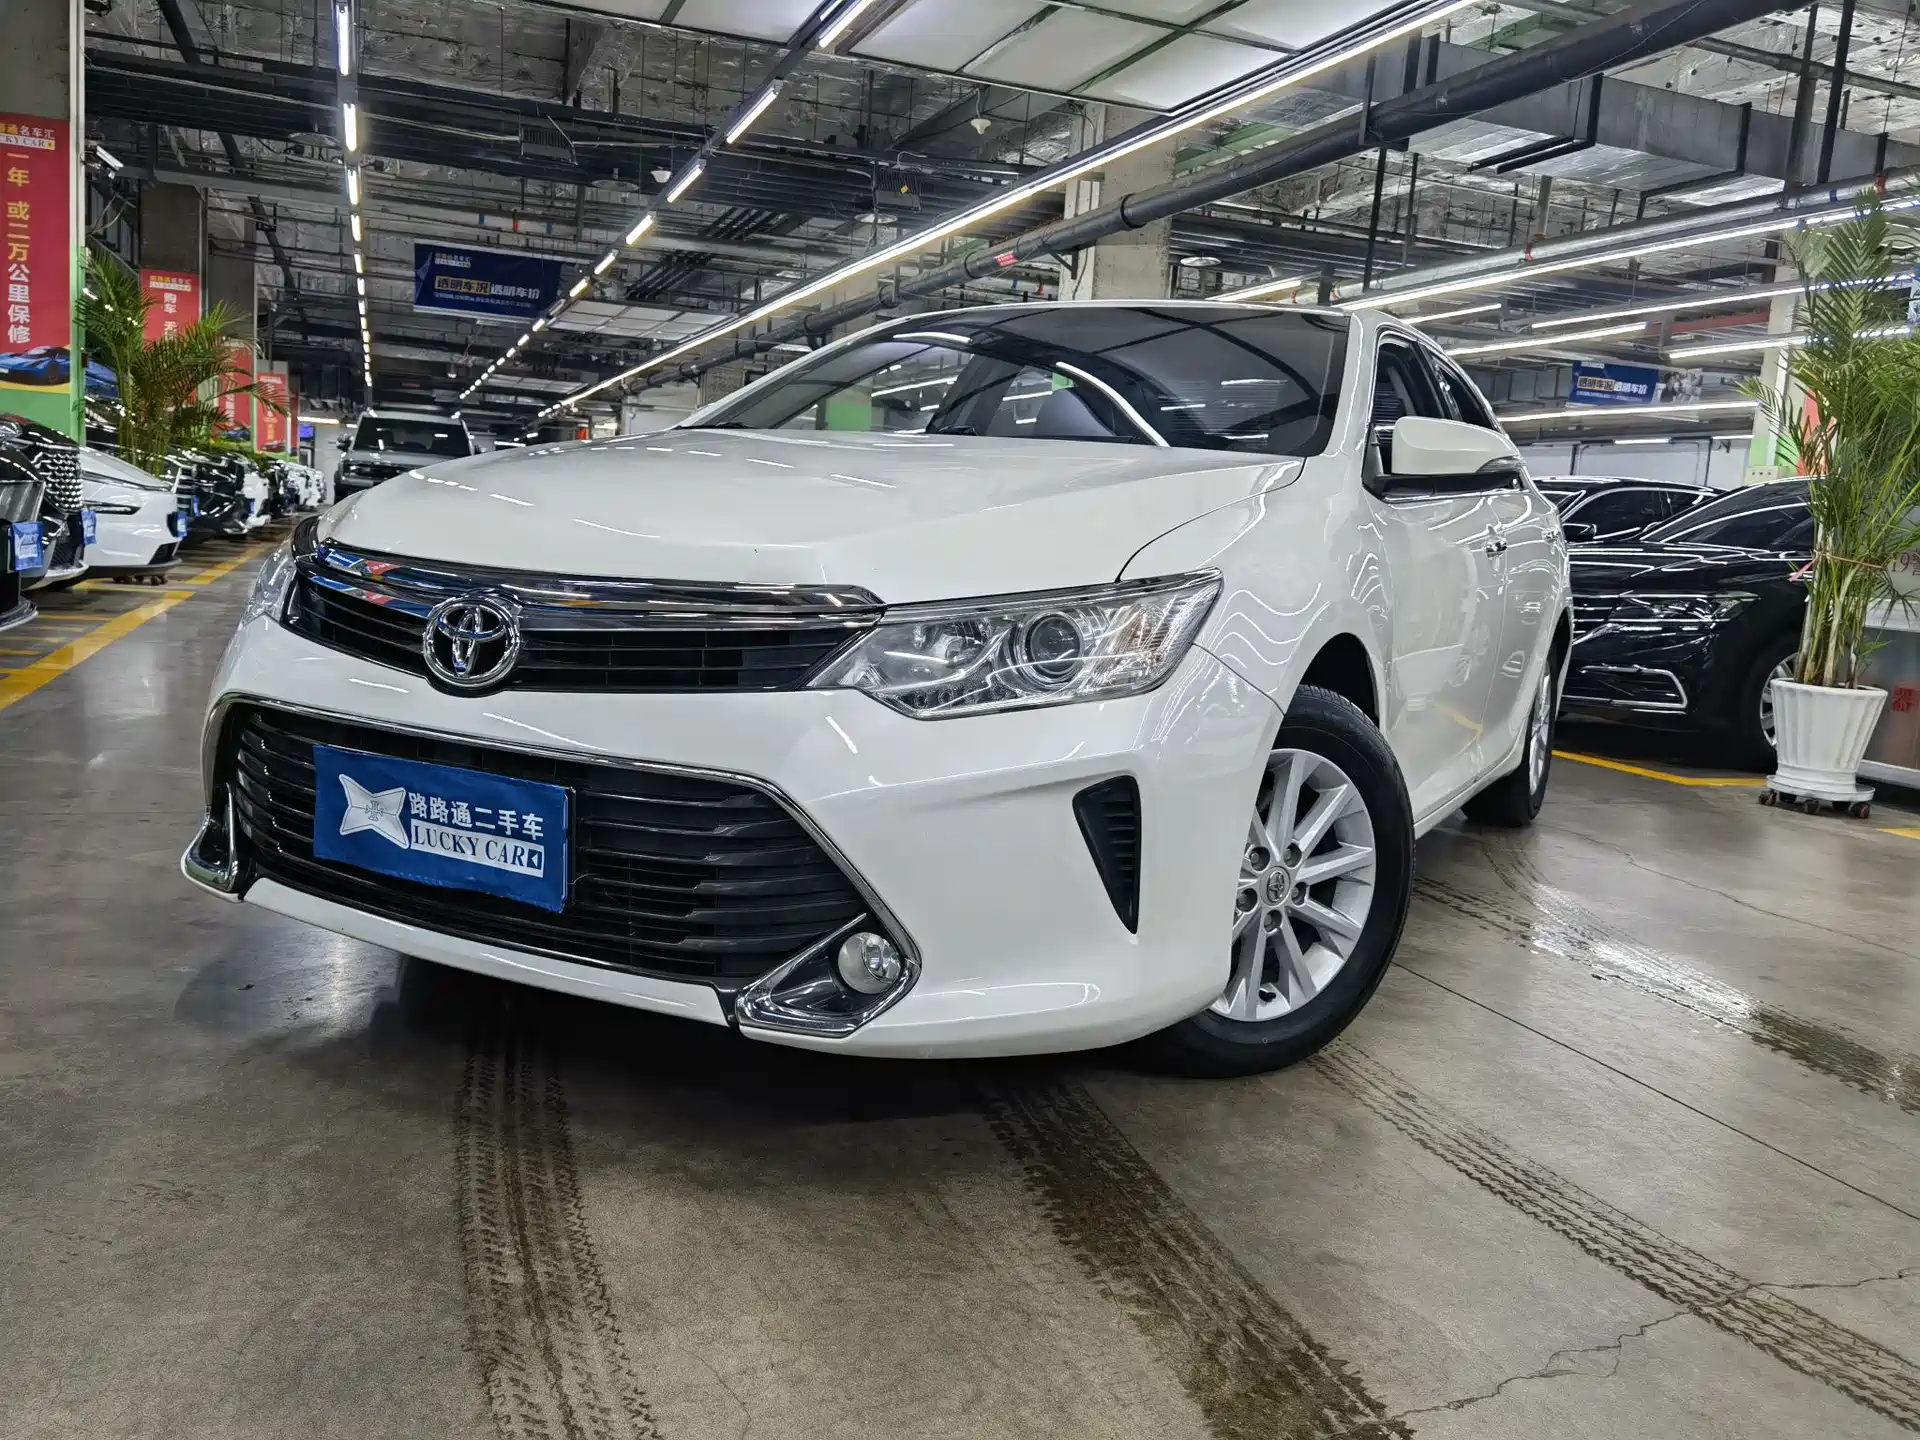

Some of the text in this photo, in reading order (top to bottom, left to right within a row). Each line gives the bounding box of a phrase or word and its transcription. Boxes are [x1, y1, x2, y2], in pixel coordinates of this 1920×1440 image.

[408, 791, 544, 841] 路路通二手车
[413, 824, 525, 867] LUCKY CAR
